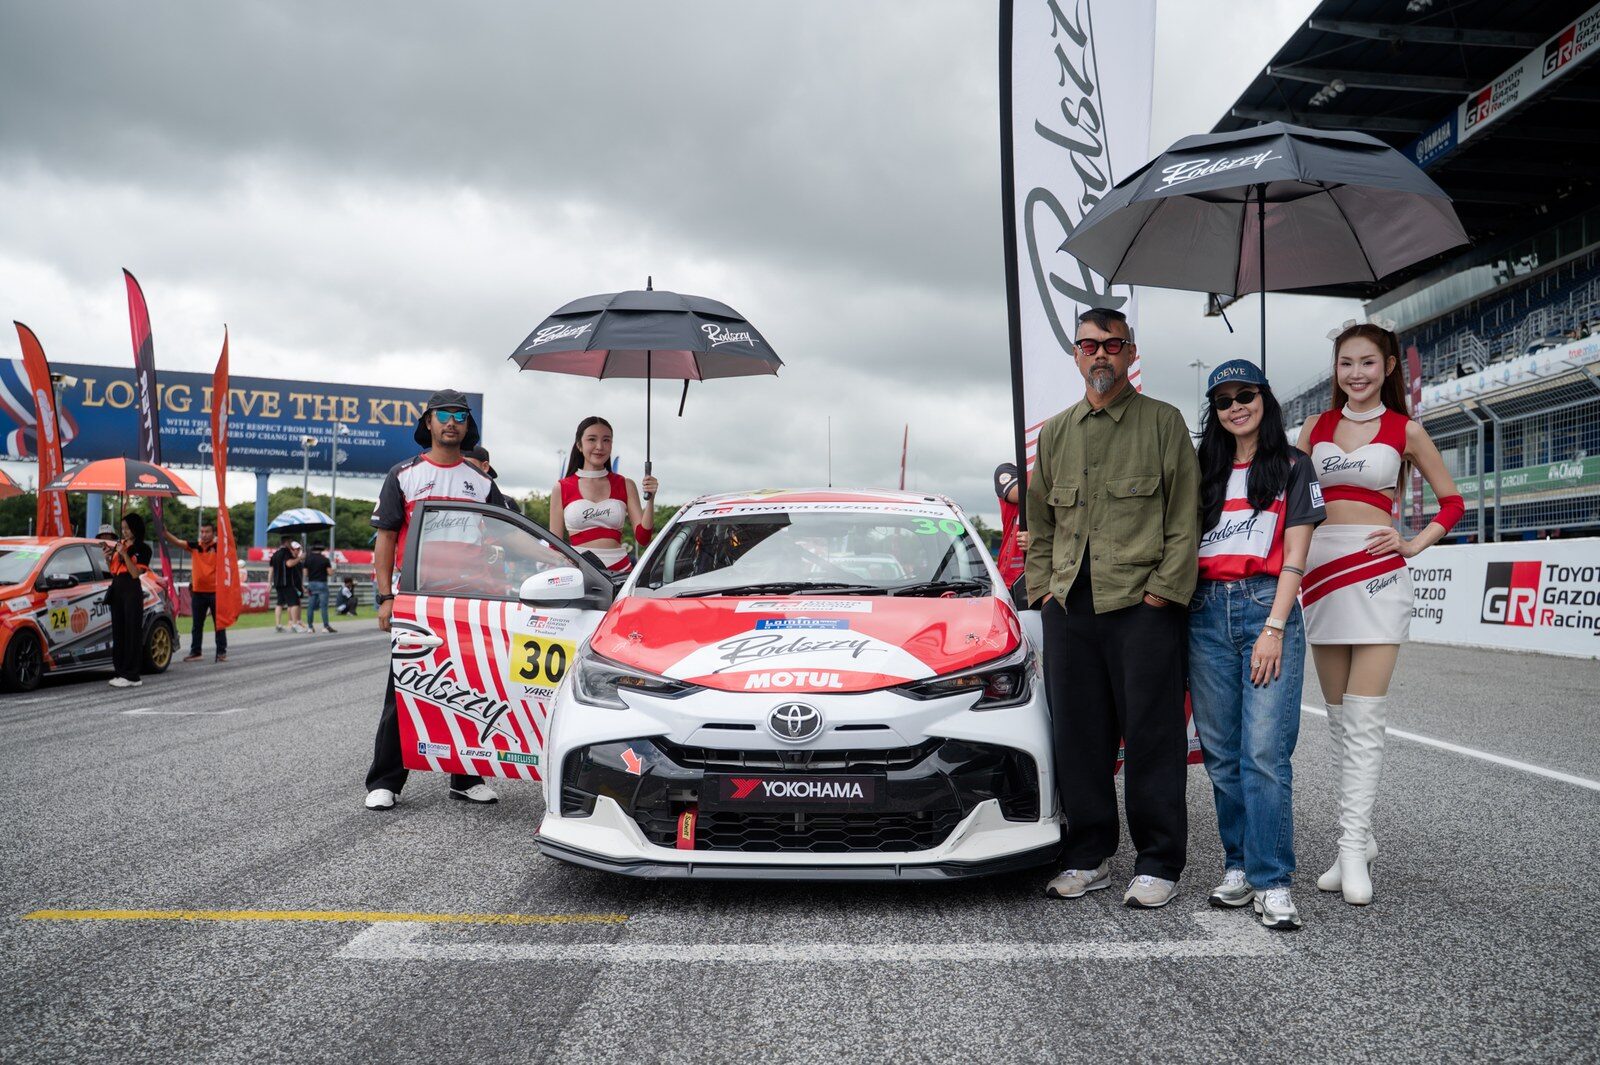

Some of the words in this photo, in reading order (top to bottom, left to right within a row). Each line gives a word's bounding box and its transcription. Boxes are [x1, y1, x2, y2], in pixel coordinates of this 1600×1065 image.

[1493, 66, 1524, 91] TOYOTA
[1492, 79, 1520, 102] GAZOO
[1490, 90, 1519, 114] Racing
[1465, 99, 1491, 130] GR
[1423, 121, 1451, 155] YAMAHA
[1154, 150, 1282, 192] Rodszzy
[525, 323, 592, 350] Rodszzy
[701, 323, 759, 347] Rodszzy
[1213, 365, 1246, 383] LOEWE
[289, 392, 360, 423] THE
[368, 398, 428, 426] KIN
[166, 418, 190, 427] WITH
[191, 419, 208, 428] THE
[246, 423, 281, 433] RESPECT
[283, 425, 306, 434] FROM
[307, 426, 324, 435] THE
[159, 427, 178, 435] AND
[245, 431, 256, 439] OF
[258, 432, 287, 442] CHANG
[353, 439, 387, 447] CIRCUIT
[232, 447, 288, 457] INTERNATIONAL
[291, 450, 320, 458] CIRUIT
[1321, 455, 1370, 476] Rodszzy
[1502, 474, 1529, 488] CIRCUIT
[1558, 462, 1584, 479] Chang
[582, 507, 612, 523] Rodszzy
[739, 505, 804, 513] TOYOTA
[909, 518, 965, 536] 30
[1408, 567, 1452, 582] TOYOTA
[1413, 587, 1446, 601] AZOO
[1411, 604, 1443, 624] acing
[1481, 586, 1537, 625] GR
[52, 611, 67, 629] 24
[519, 640, 567, 683] 30
[711, 634, 888, 675] Rodszzy
[744, 671, 844, 690] MOTUL
[460, 749, 493, 758] LENSO
[762, 780, 864, 798] YOKOHAMA
